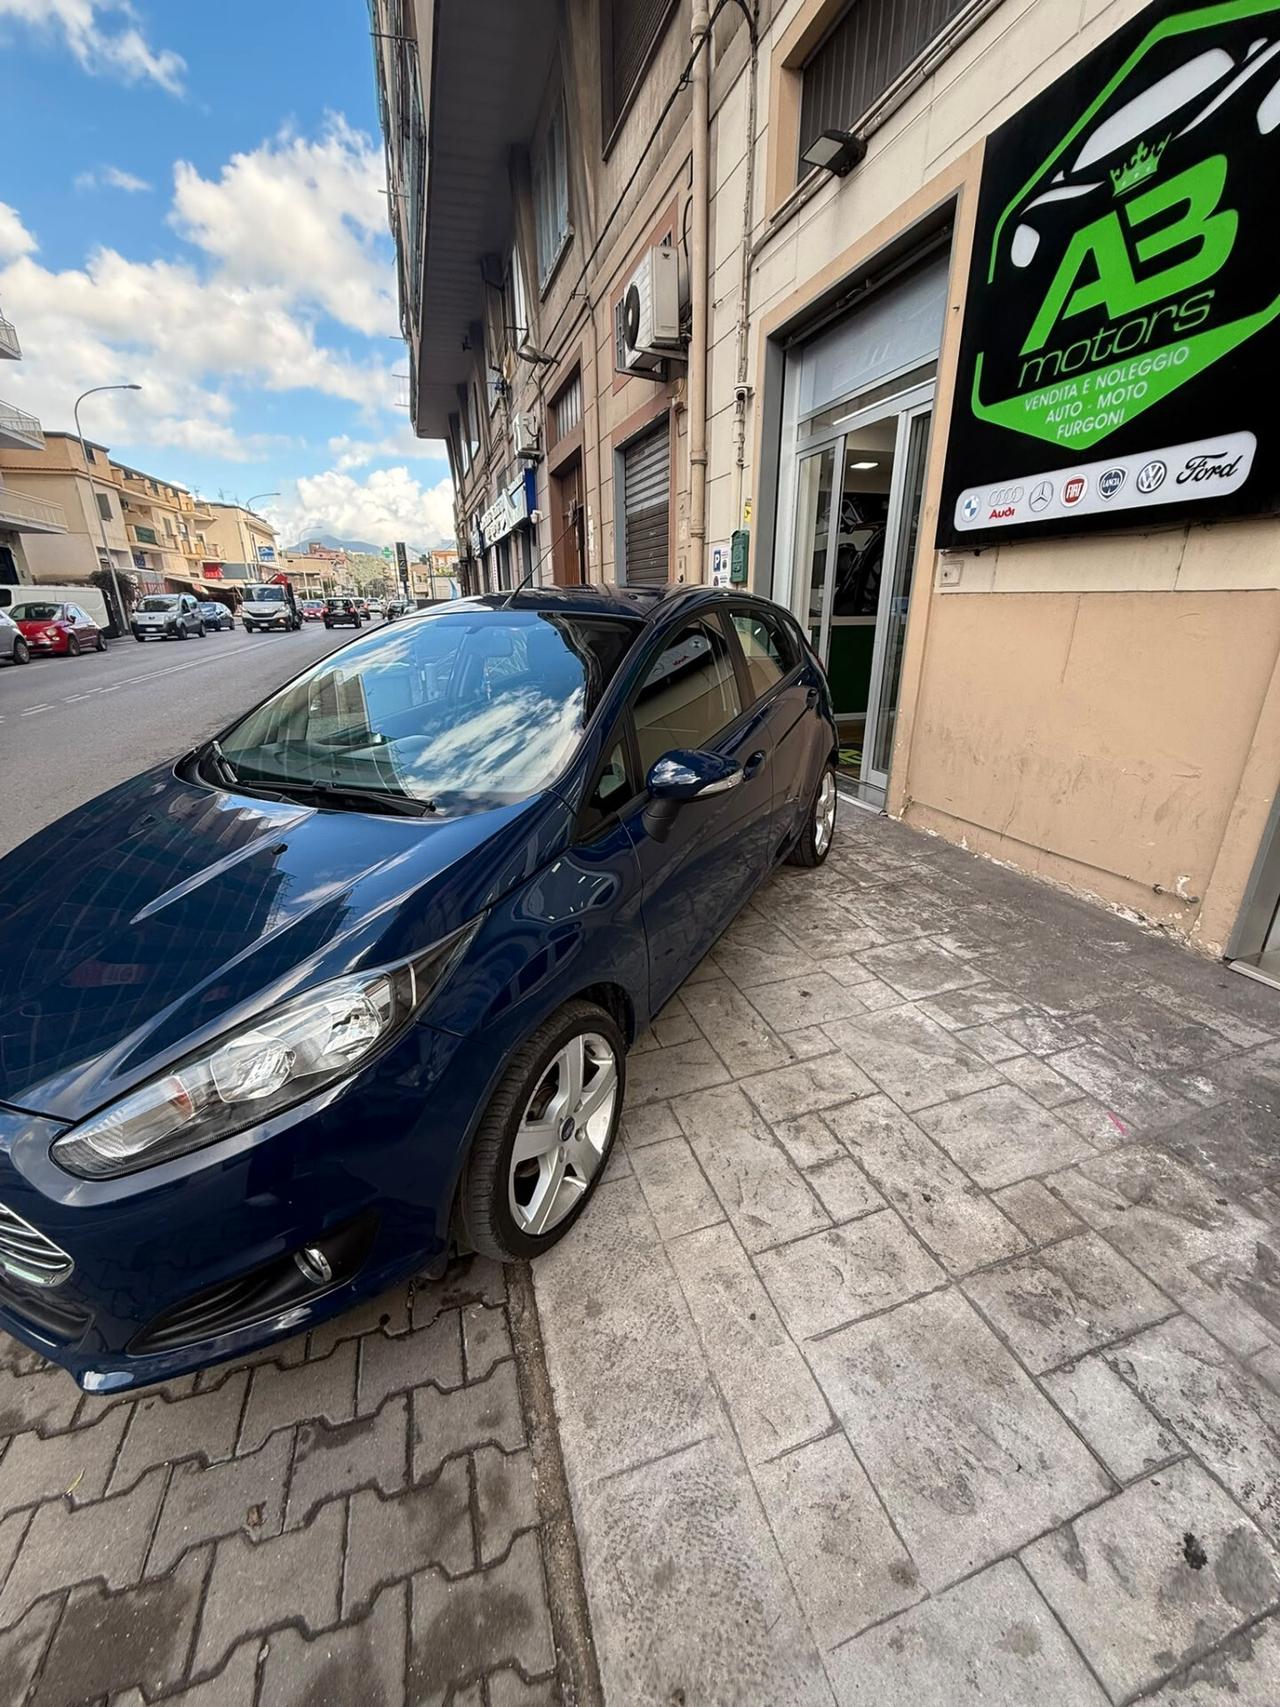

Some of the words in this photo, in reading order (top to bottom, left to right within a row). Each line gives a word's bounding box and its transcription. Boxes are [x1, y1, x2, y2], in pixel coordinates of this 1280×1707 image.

[1018, 153, 1239, 357] AB
[1017, 289, 1215, 388] motors
[1025, 383, 1078, 411] VENDITA
[1082, 378, 1092, 394] E
[1095, 346, 1190, 390] NOLEGGIO
[1045, 401, 1083, 424] AUTO
[1097, 381, 1148, 409] MOTO
[1056, 408, 1125, 440] FURGONI
[1176, 451, 1244, 484] Ford
[1066, 482, 1083, 499] FIAT
[989, 507, 1016, 519] Audi
